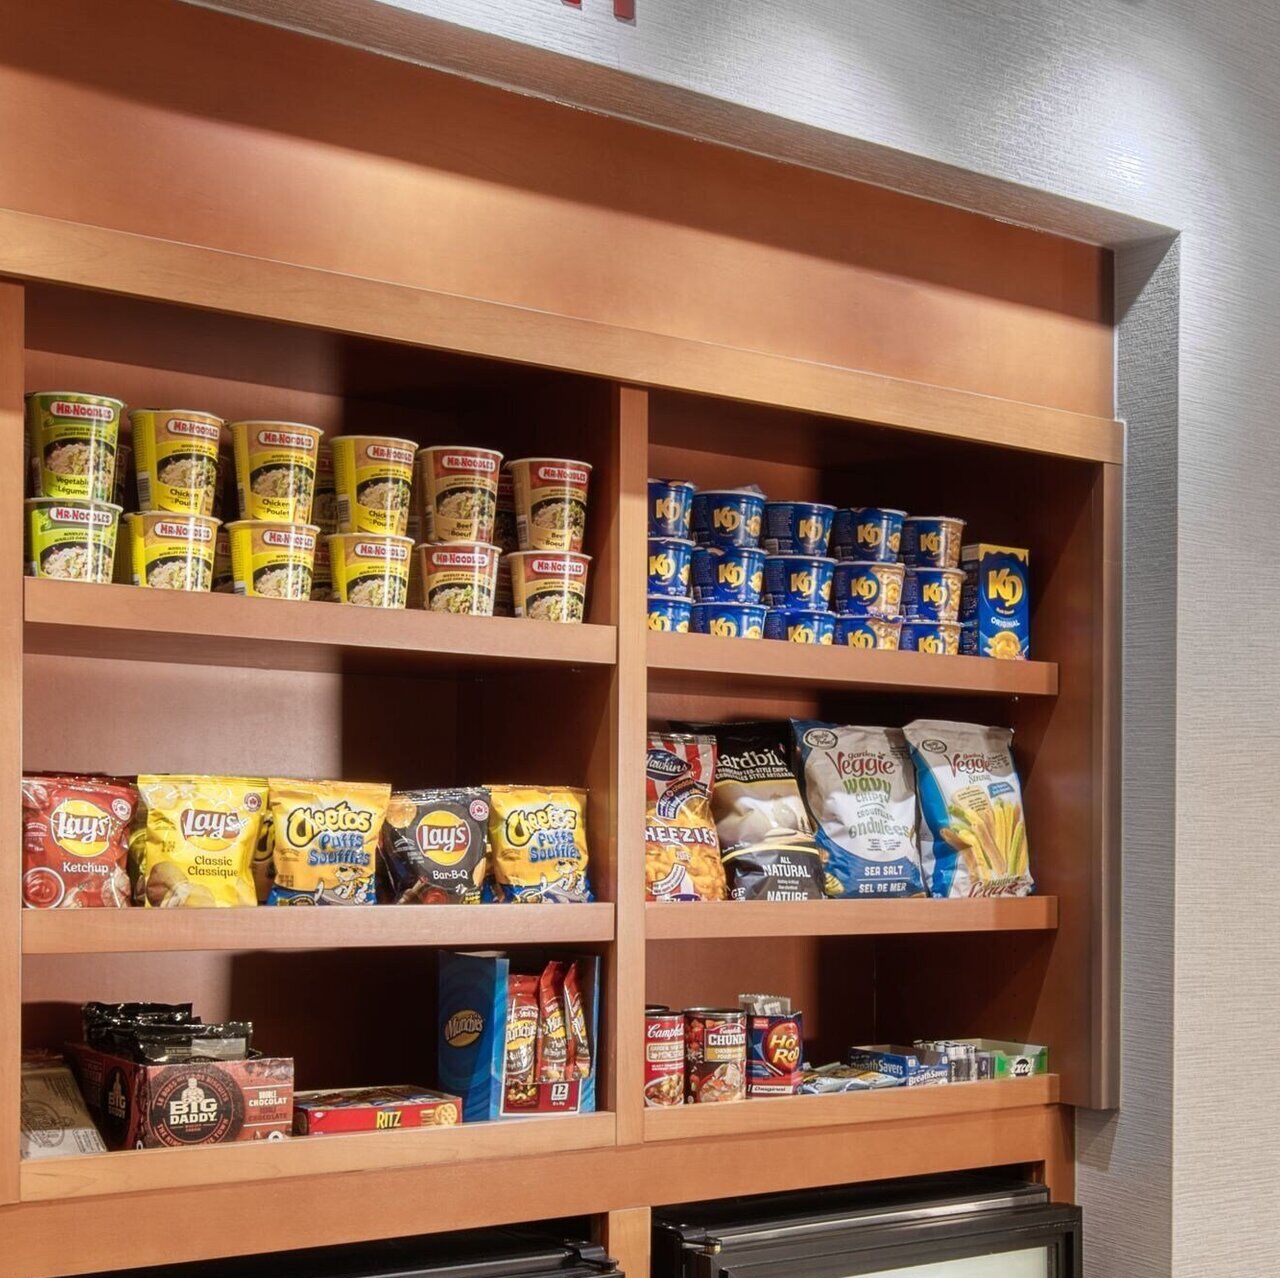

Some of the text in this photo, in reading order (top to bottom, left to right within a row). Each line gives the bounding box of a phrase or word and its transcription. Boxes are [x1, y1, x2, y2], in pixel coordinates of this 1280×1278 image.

[988, 568, 1023, 607] KD
[990, 617, 1020, 628] ORIGINAL
[826, 751, 896, 779] Veggie
[843, 776, 892, 798] wavy
[287, 802, 372, 847] Cheetos
[506, 804, 578, 846] Cheetos
[320, 834, 364, 849] Puffs
[422, 824, 467, 851] Lay's
[538, 830, 574, 846] Puffs
[194, 856, 232, 866] Classic
[780, 856, 791, 865] ALL
[62, 861, 109, 875] Ketchup
[188, 866, 239, 879] Classique
[432, 869, 468, 881] Bar-B-Q
[764, 864, 812, 878] NATURAL
[864, 865, 904, 876] SEA SALT
[858, 882, 907, 894] SEL DE MER
[447, 1012, 484, 1038] Munchies
[554, 1085, 566, 1095] 12
[170, 1098, 218, 1114] BIG
[248, 1097, 288, 1106] CHOCOLAT
[376, 1110, 402, 1128] RITZ
